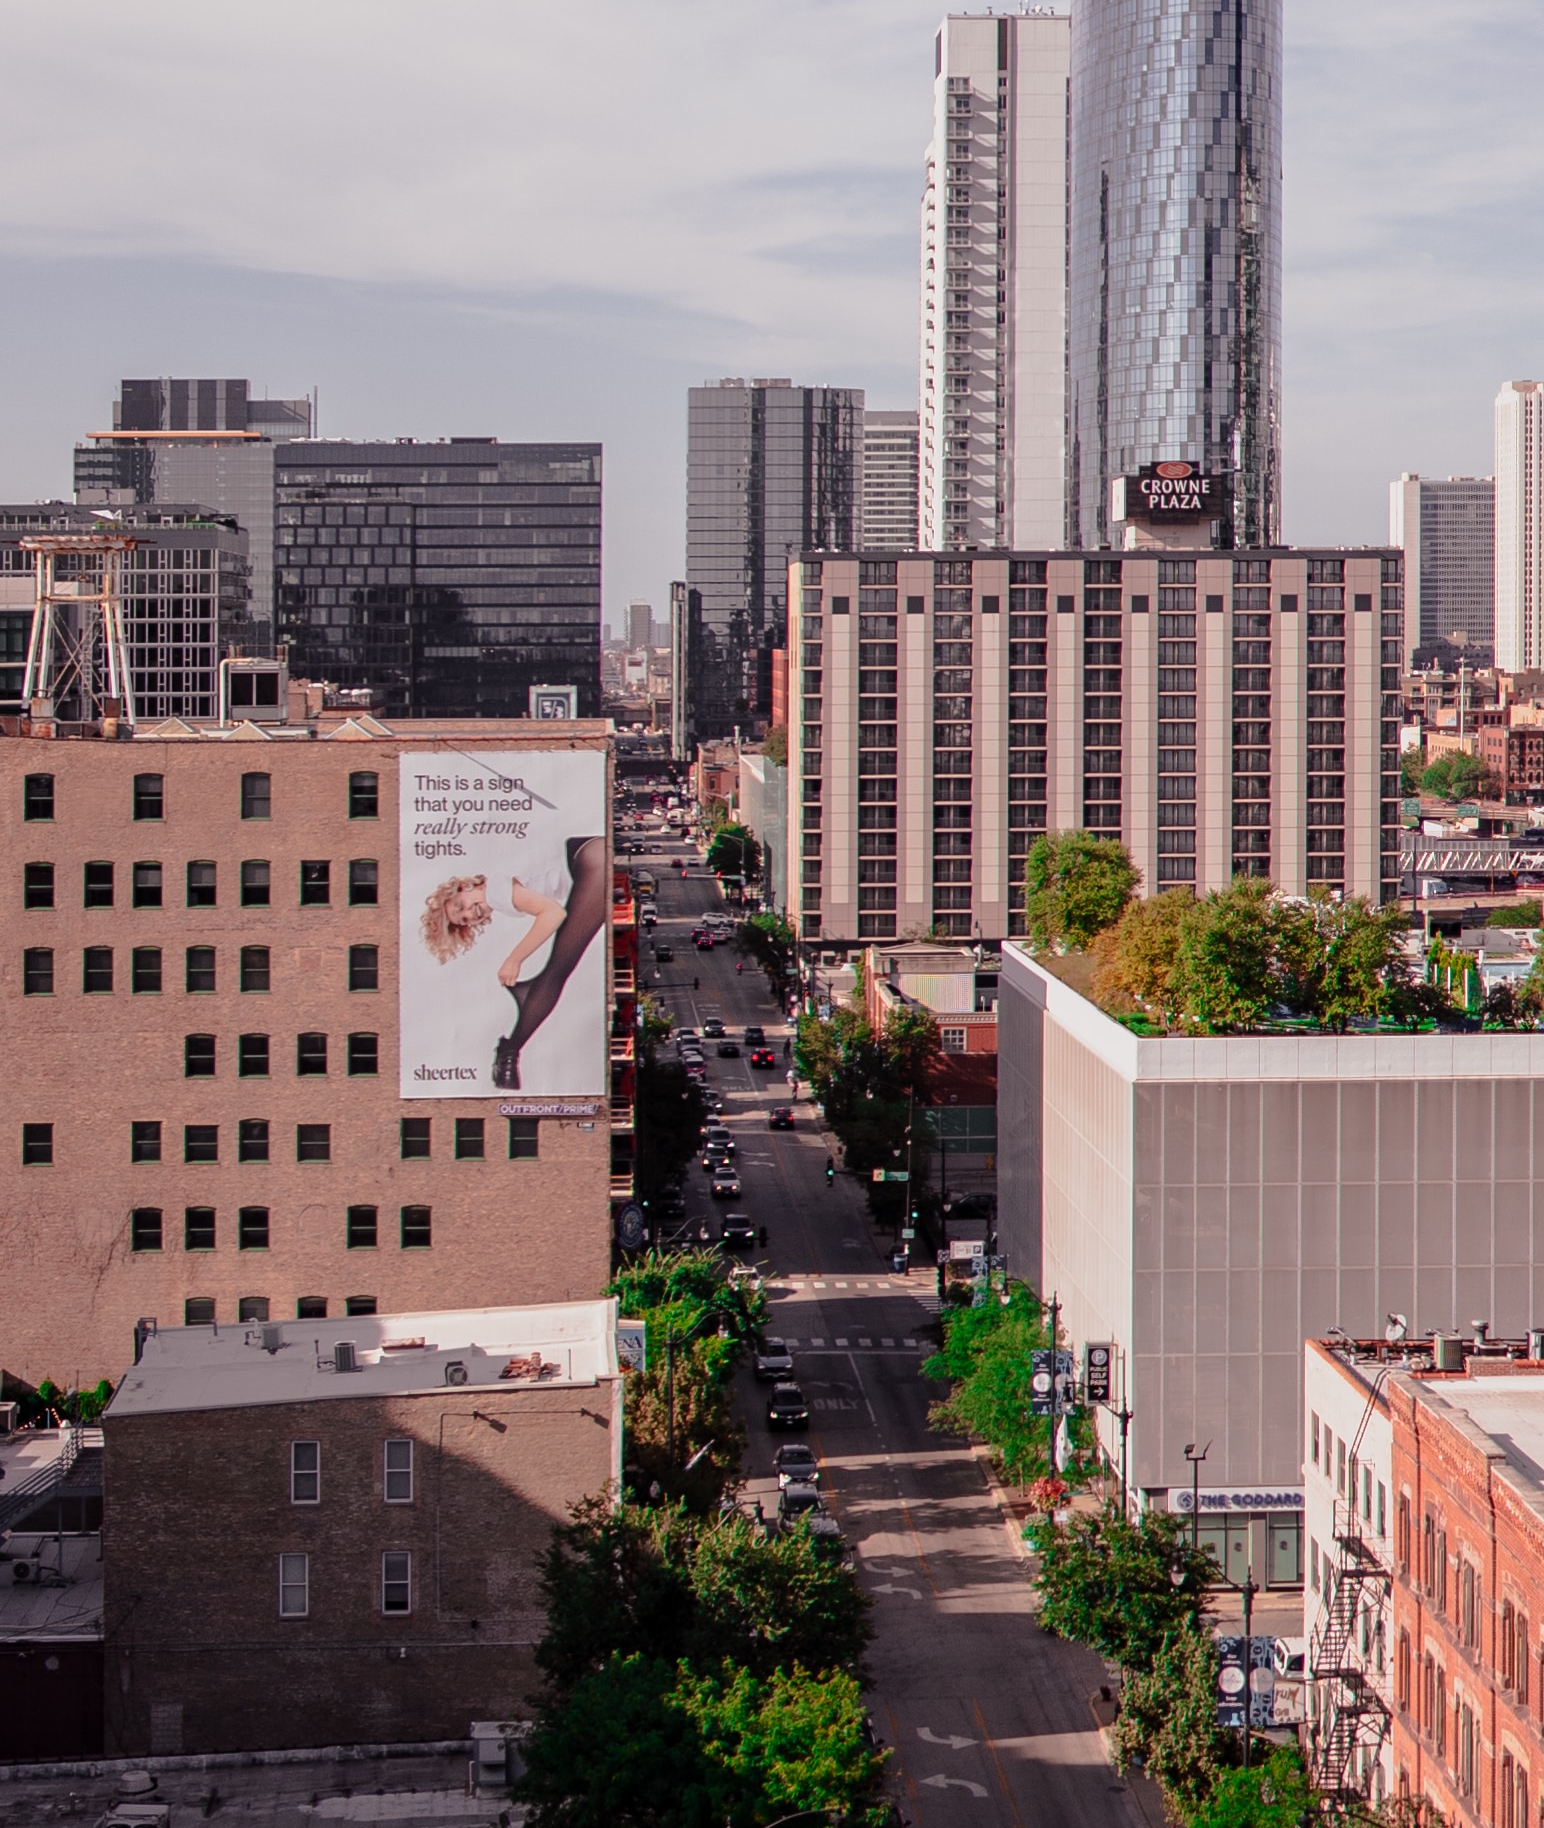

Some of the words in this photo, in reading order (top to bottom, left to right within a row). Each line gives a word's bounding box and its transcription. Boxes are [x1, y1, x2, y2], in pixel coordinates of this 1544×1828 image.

[1141, 479, 1211, 494] CROWNE
[1149, 494, 1202, 509] PLAZA
[414, 774, 450, 791] This
[455, 774, 469, 791] is
[473, 778, 484, 791] a
[488, 774, 525, 793] sign
[414, 797, 448, 812] that
[452, 799, 485, 815] you
[489, 796, 533, 811] need
[414, 818, 468, 839] really
[470, 820, 530, 839] strong
[414, 841, 467, 860] tights.
[414, 1064, 477, 1081] sheertex
[813, 1397, 860, 1410] ONLY
[1200, 1494, 1228, 1507] THE
[1231, 1492, 1302, 1506] GODDARD
